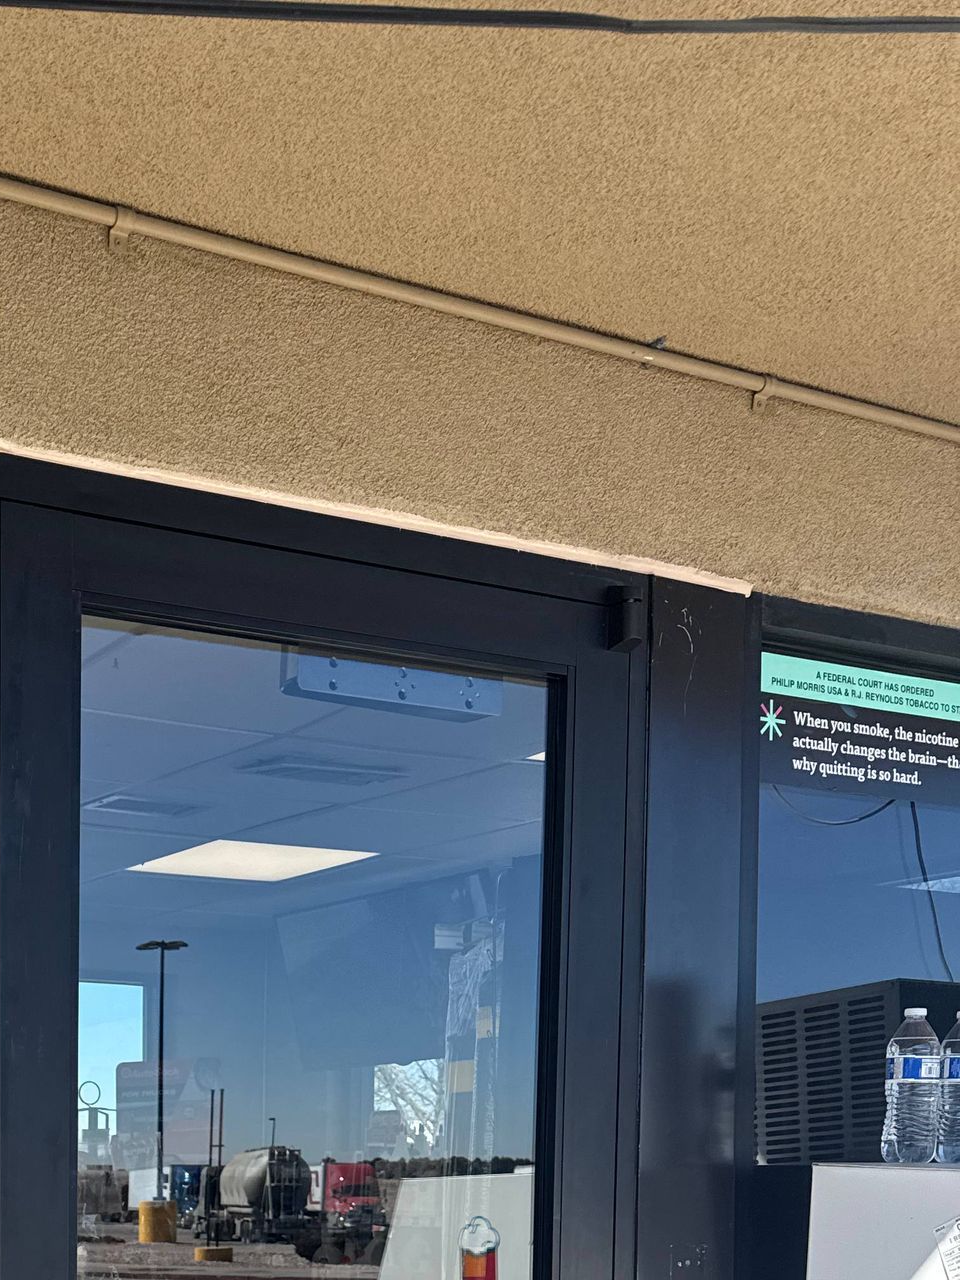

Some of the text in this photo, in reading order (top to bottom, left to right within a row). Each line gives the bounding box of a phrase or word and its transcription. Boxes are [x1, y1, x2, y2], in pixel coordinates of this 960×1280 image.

[771, 676, 795, 688] PHILIP
[796, 680, 826, 694] MORRIS
[826, 685, 843, 696] USA
[844, 688, 850, 697] &
[851, 688, 864, 700] R.J.
[865, 691, 904, 706] REYNOLDS
[905, 697, 940, 711] TOBACCO
[941, 703, 950, 713] TO
[815, 671, 935, 698] A FEDERAL COURT HAS ORDERED
[793, 710, 959, 748] When you smoke, the nicotine
[792, 736, 840, 756] actually
[840, 740, 887, 762] changes
[887, 746, 907, 762] the
[792, 756, 922, 786] why quitting is so hard.
